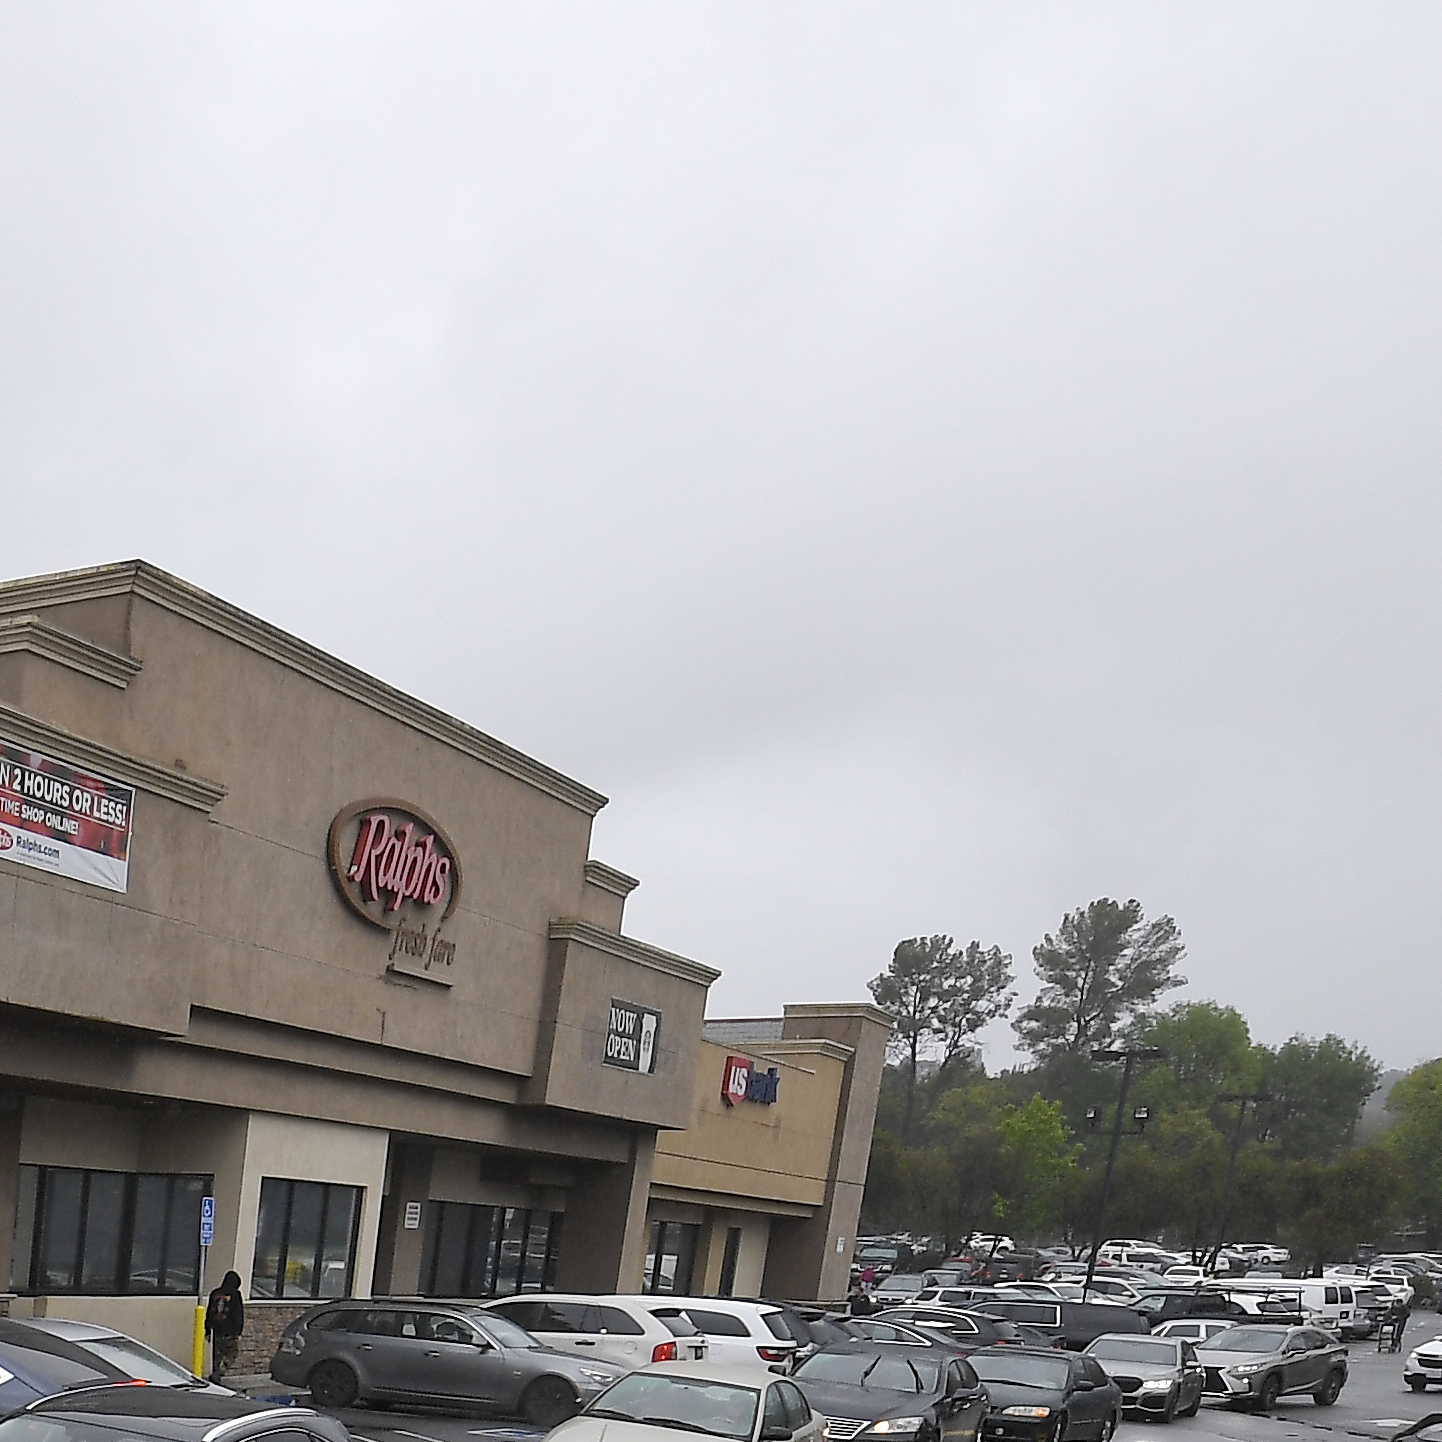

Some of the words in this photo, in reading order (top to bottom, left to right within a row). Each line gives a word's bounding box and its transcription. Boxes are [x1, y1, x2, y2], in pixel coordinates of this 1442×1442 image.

[12, 768, 22, 790] 2
[23, 771, 70, 807] HOURS
[72, 789, 91, 816] OR
[93, 795, 127, 826] LESS!
[0, 796, 19, 817] TIME
[21, 804, 44, 826] SHOP
[45, 813, 79, 836] ONLINE!
[16, 835, 60, 859] Ralphs.com
[354, 814, 451, 912] Ralphs
[609, 1007, 638, 1035] NOW
[607, 1033, 637, 1062] OPEN
